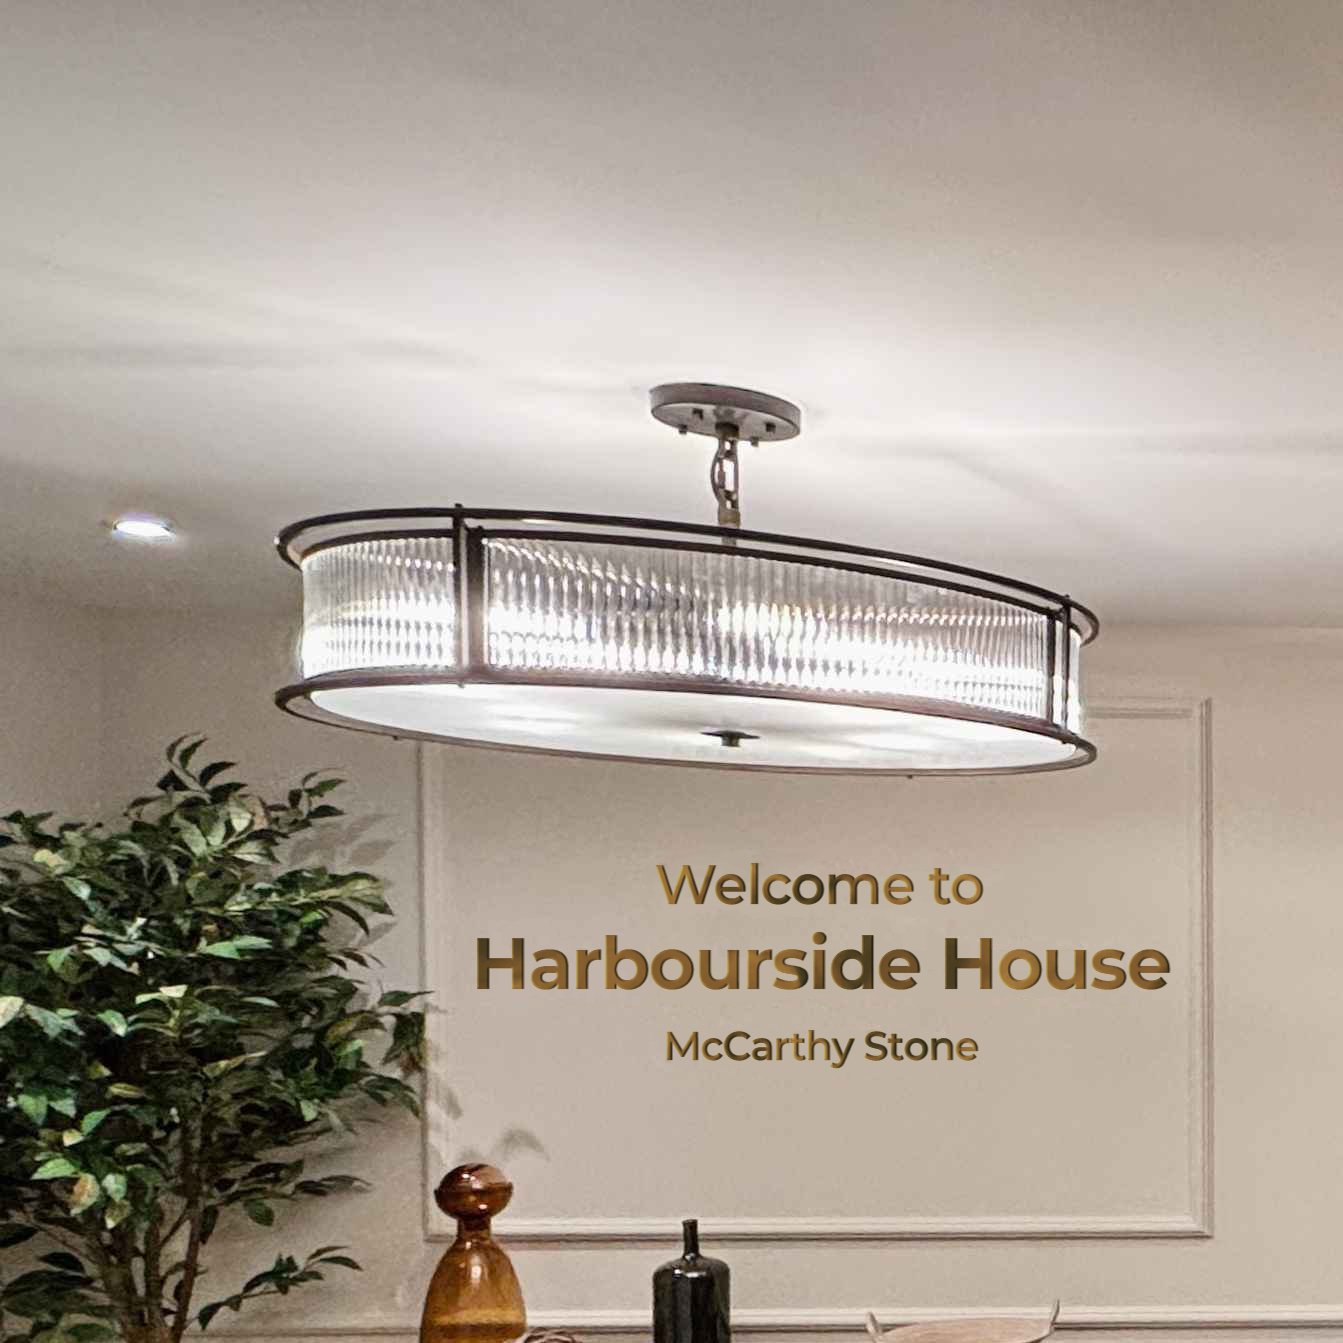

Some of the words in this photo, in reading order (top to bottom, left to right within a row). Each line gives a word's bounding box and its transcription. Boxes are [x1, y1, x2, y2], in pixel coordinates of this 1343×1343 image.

[656, 862, 914, 906] Welcome
[928, 867, 984, 906] to
[476, 931, 921, 991] Harbourside
[944, 937, 1170, 991] House
[666, 1029, 855, 1069] McCarthy
[864, 1030, 979, 1062] Stone
